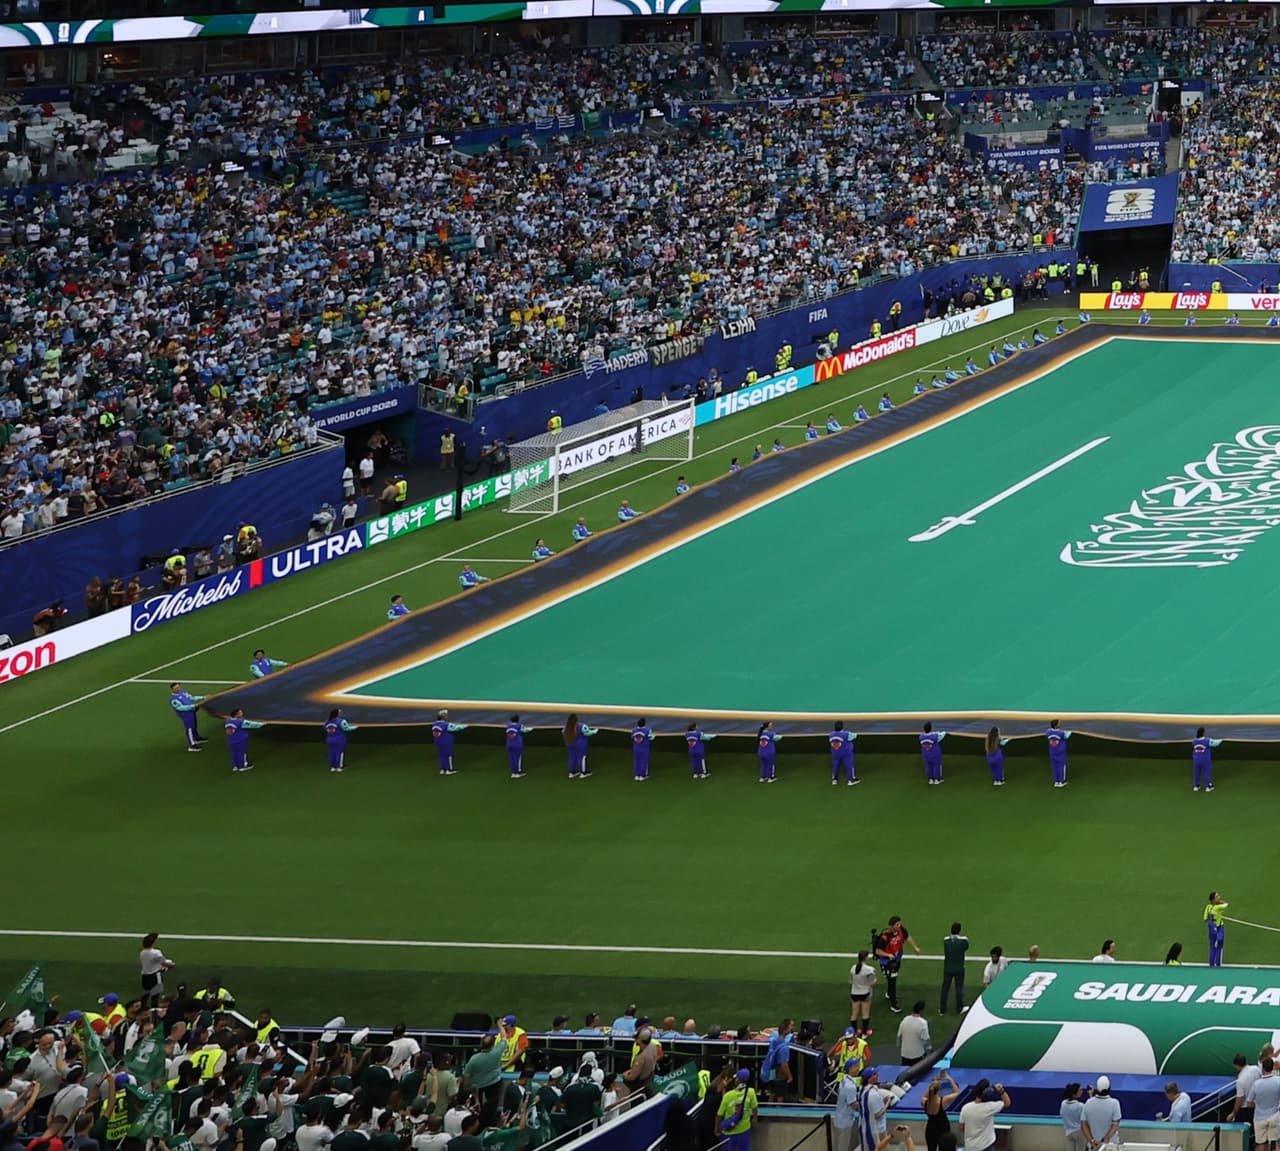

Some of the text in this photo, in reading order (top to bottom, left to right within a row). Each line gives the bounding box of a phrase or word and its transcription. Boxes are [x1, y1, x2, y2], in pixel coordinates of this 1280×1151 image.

[1109, 292, 1141, 309] Lay's
[1176, 292, 1208, 309] Lay's
[808, 308, 828, 323] FIFA
[940, 316, 971, 337] Dove
[604, 349, 648, 374] HADERN
[844, 331, 914, 371] McDonald's
[714, 376, 798, 420] Hisense
[327, 411, 355, 428] WORLD
[356, 406, 371, 419] CUP
[372, 398, 398, 412] 2026
[598, 439, 615, 458] OF
[133, 528, 364, 633] Michelob ULTRA
[1074, 981, 1195, 1004] SAUDI
